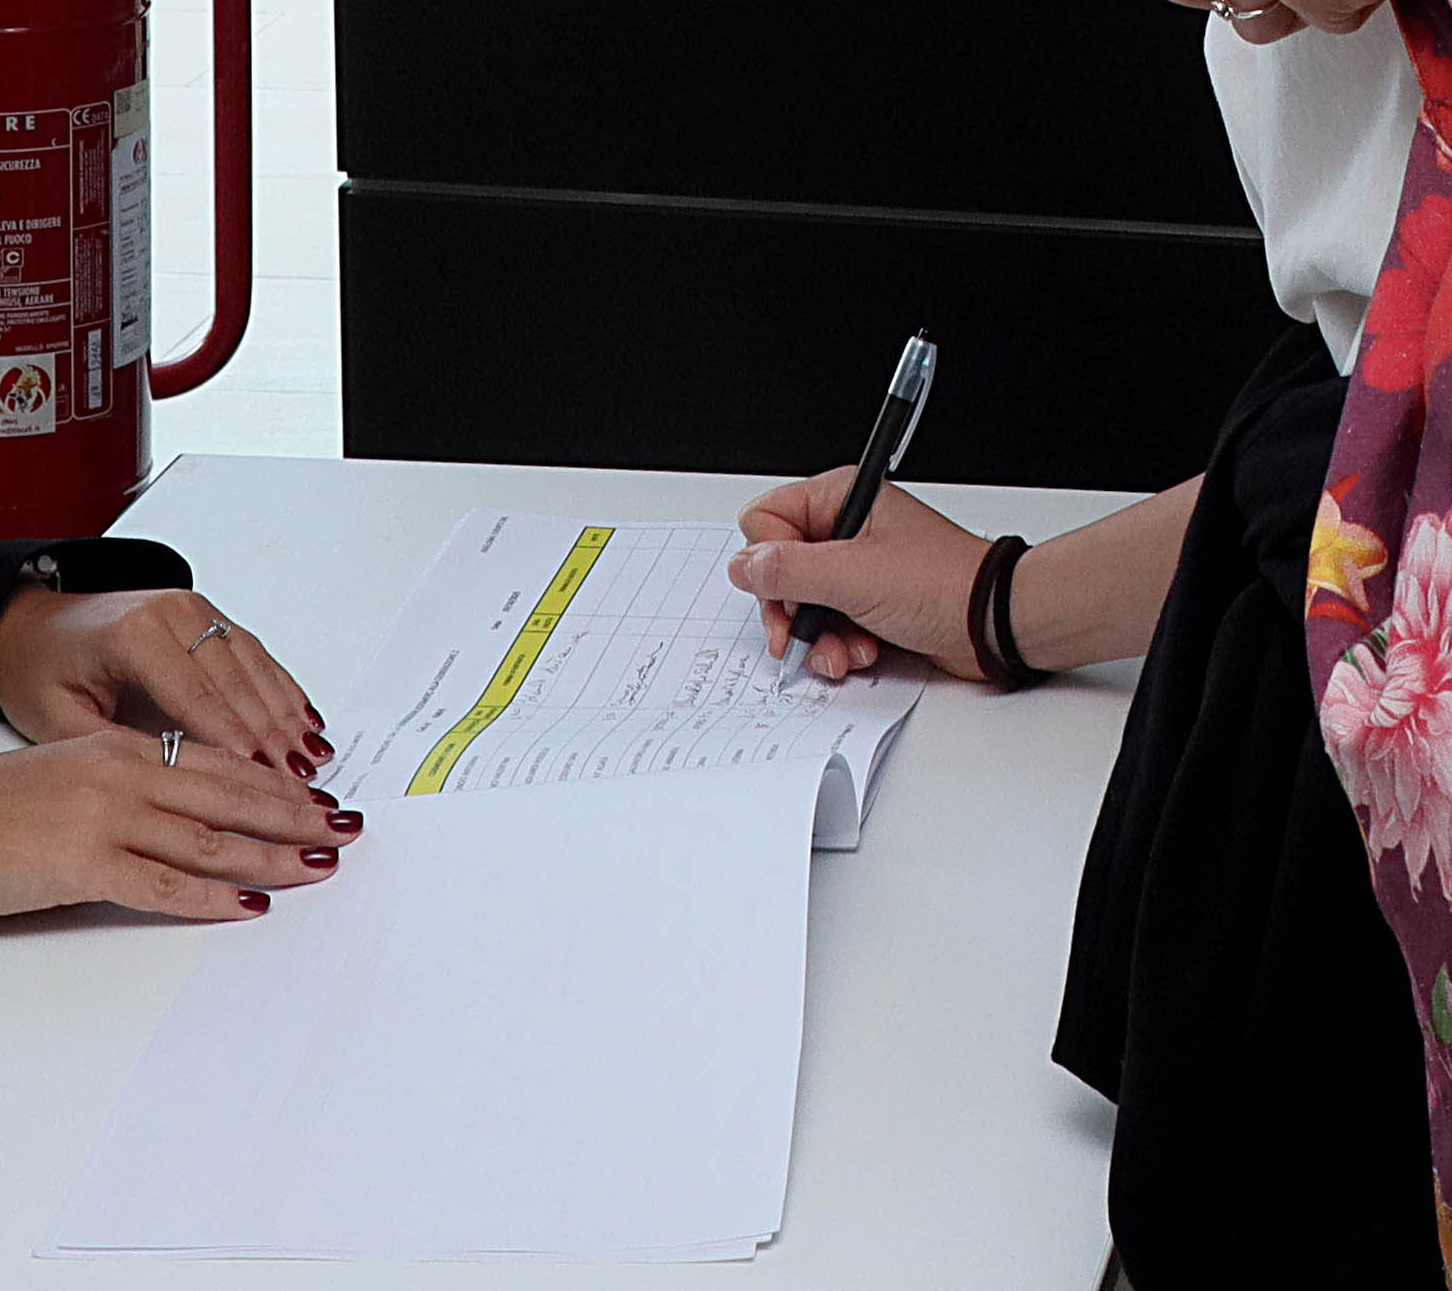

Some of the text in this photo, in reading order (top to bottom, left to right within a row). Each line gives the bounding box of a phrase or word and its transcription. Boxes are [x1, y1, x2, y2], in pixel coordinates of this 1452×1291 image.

[19, 219, 24, 230] E
[25, 216, 61, 230] DIRIGERE
[4, 233, 32, 245] FUOCO
[5, 250, 21, 265] C
[3, 286, 40, 298] TENSIONE
